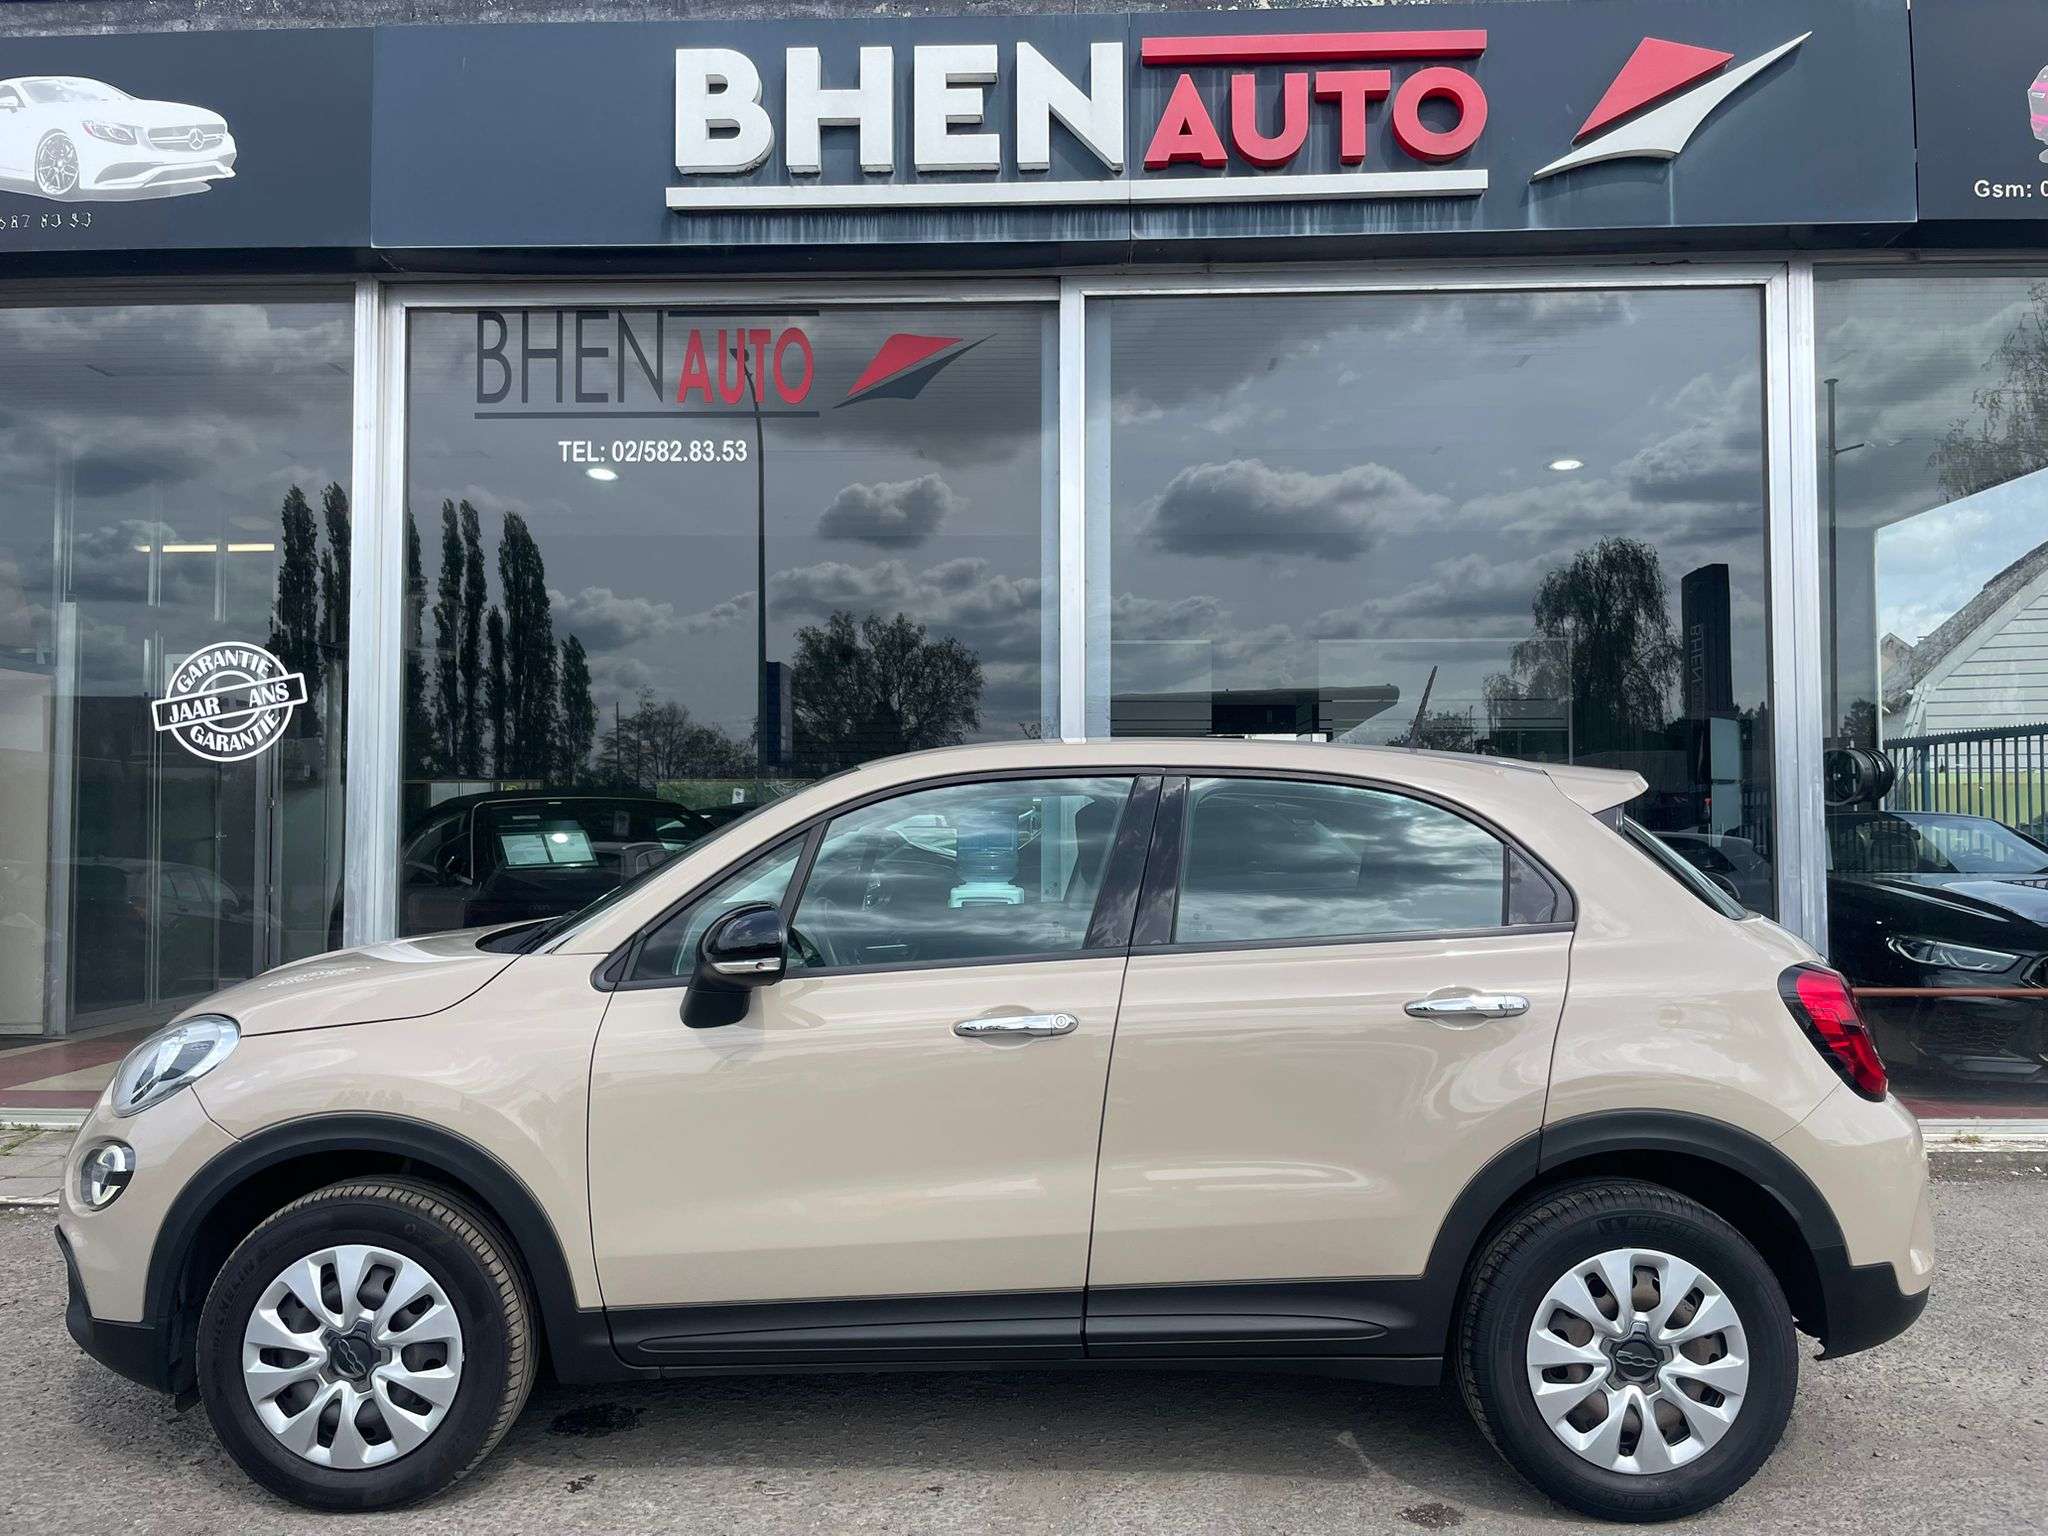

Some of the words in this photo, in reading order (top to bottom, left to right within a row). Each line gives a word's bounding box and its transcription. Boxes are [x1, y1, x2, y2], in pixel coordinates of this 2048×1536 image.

[676, 41, 1124, 175] BHEN
[1144, 67, 1488, 170] AUTO
[1974, 180, 2032, 198] Gsm:
[476, 310, 663, 404] BHEN
[677, 327, 815, 405] AUTO
[558, 441, 605, 462] TEL:
[612, 440, 748, 462] 02/582.83.53
[176, 649, 273, 693] GARANTIE
[169, 697, 221, 723] JAAR
[249, 682, 290, 709] ANS
[189, 709, 281, 752] GARANTIE
